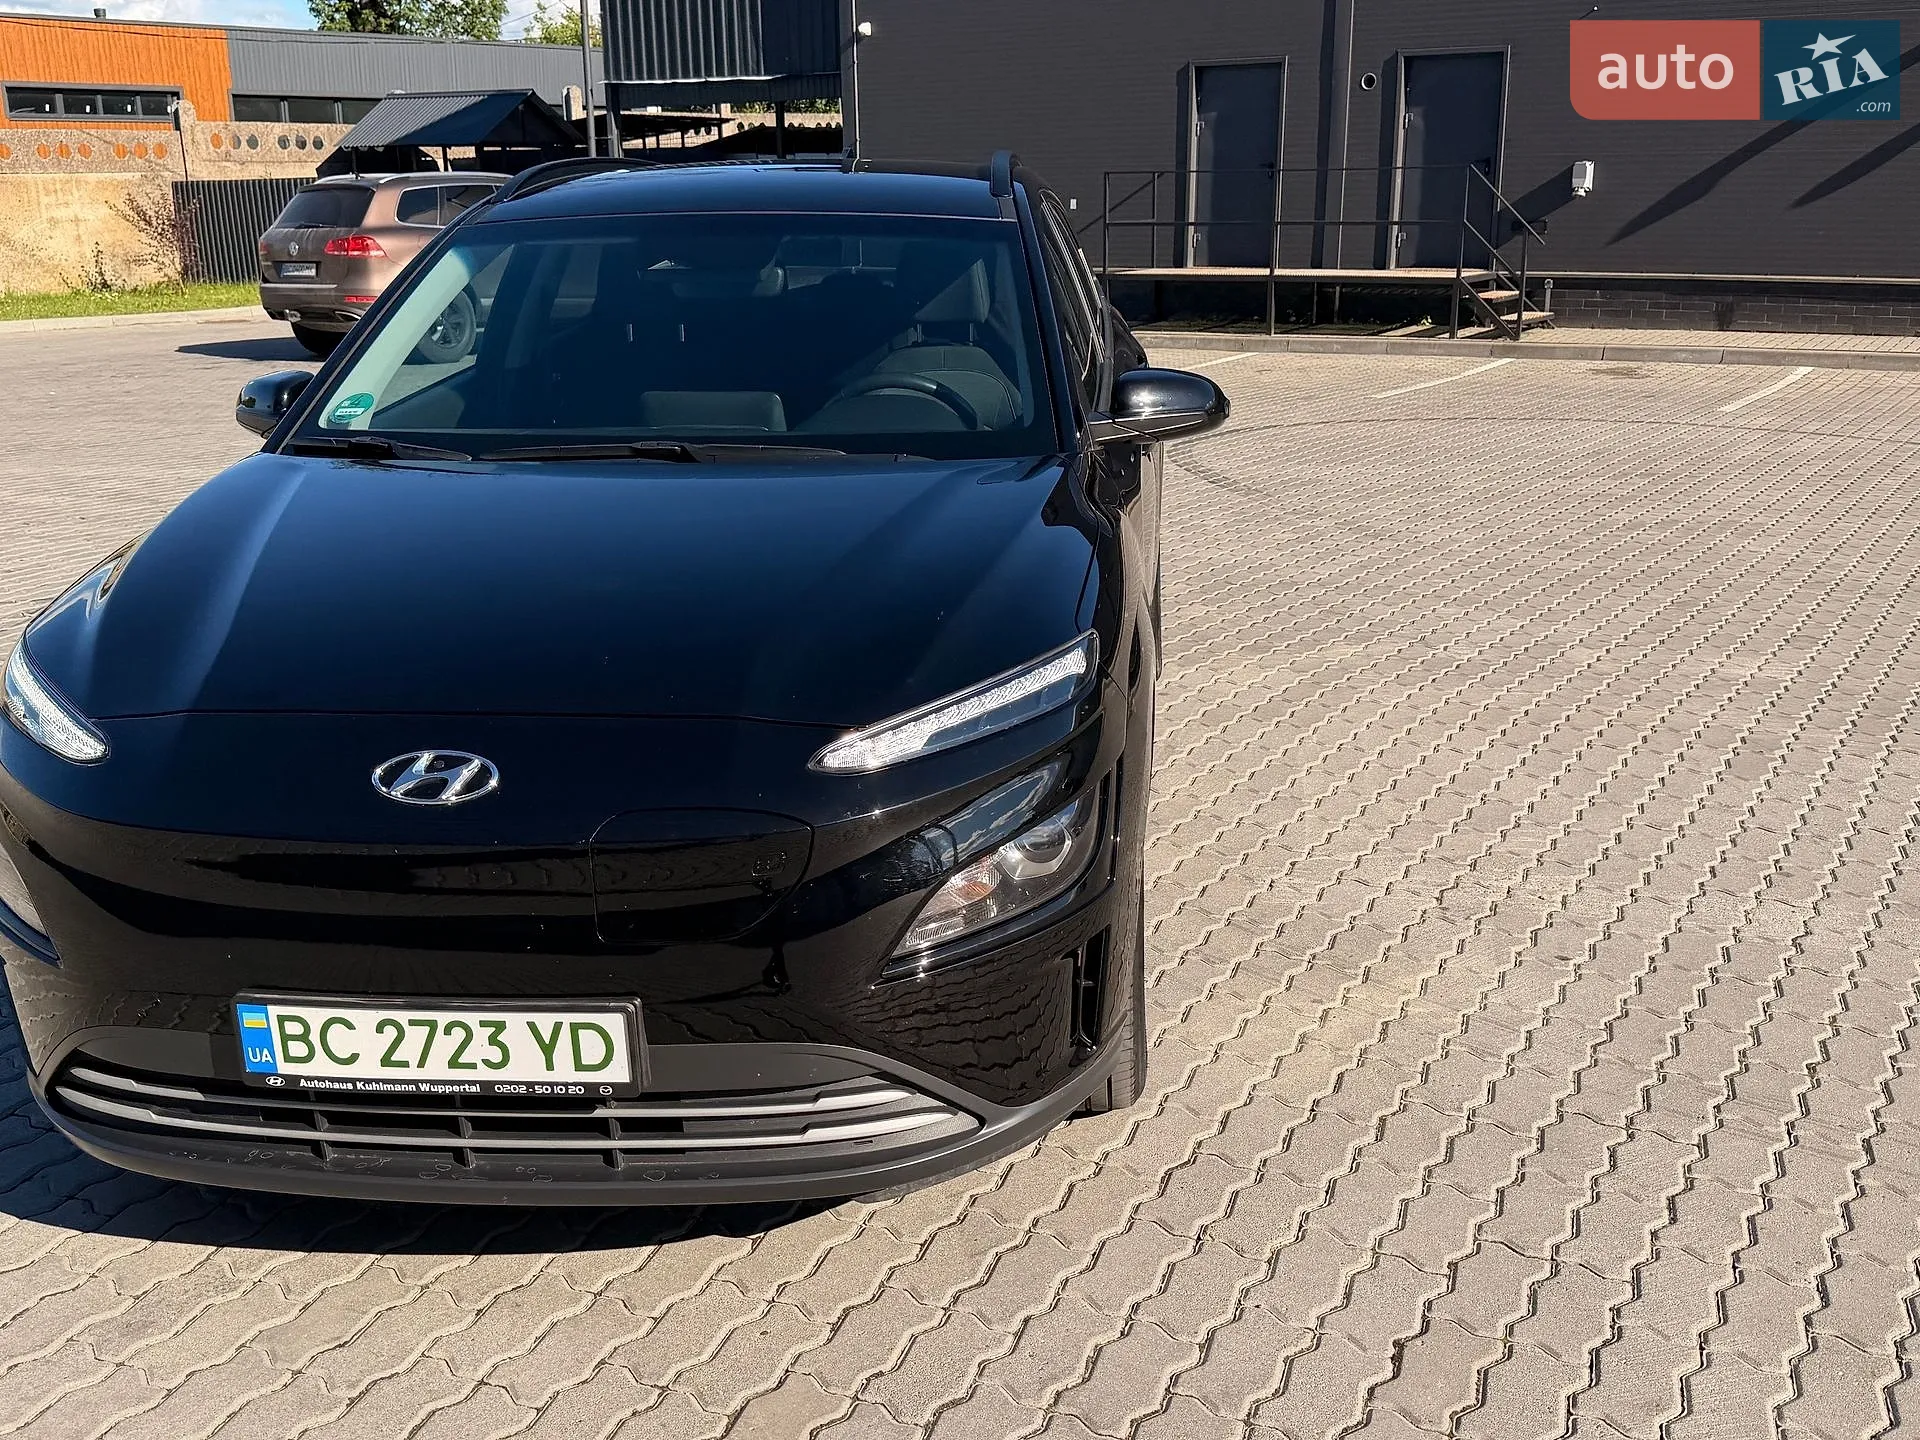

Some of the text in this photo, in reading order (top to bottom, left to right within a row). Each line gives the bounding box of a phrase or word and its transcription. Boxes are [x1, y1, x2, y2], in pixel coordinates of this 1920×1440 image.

[277, 1013, 615, 1072] BC 2723 YD
[248, 1047, 274, 1063] UA
[300, 1078, 353, 1090] Autohaus
[356, 1081, 416, 1092] Kuhlmann
[419, 1083, 480, 1094] Wuppertal
[567, 1087, 584, 1095] 20
